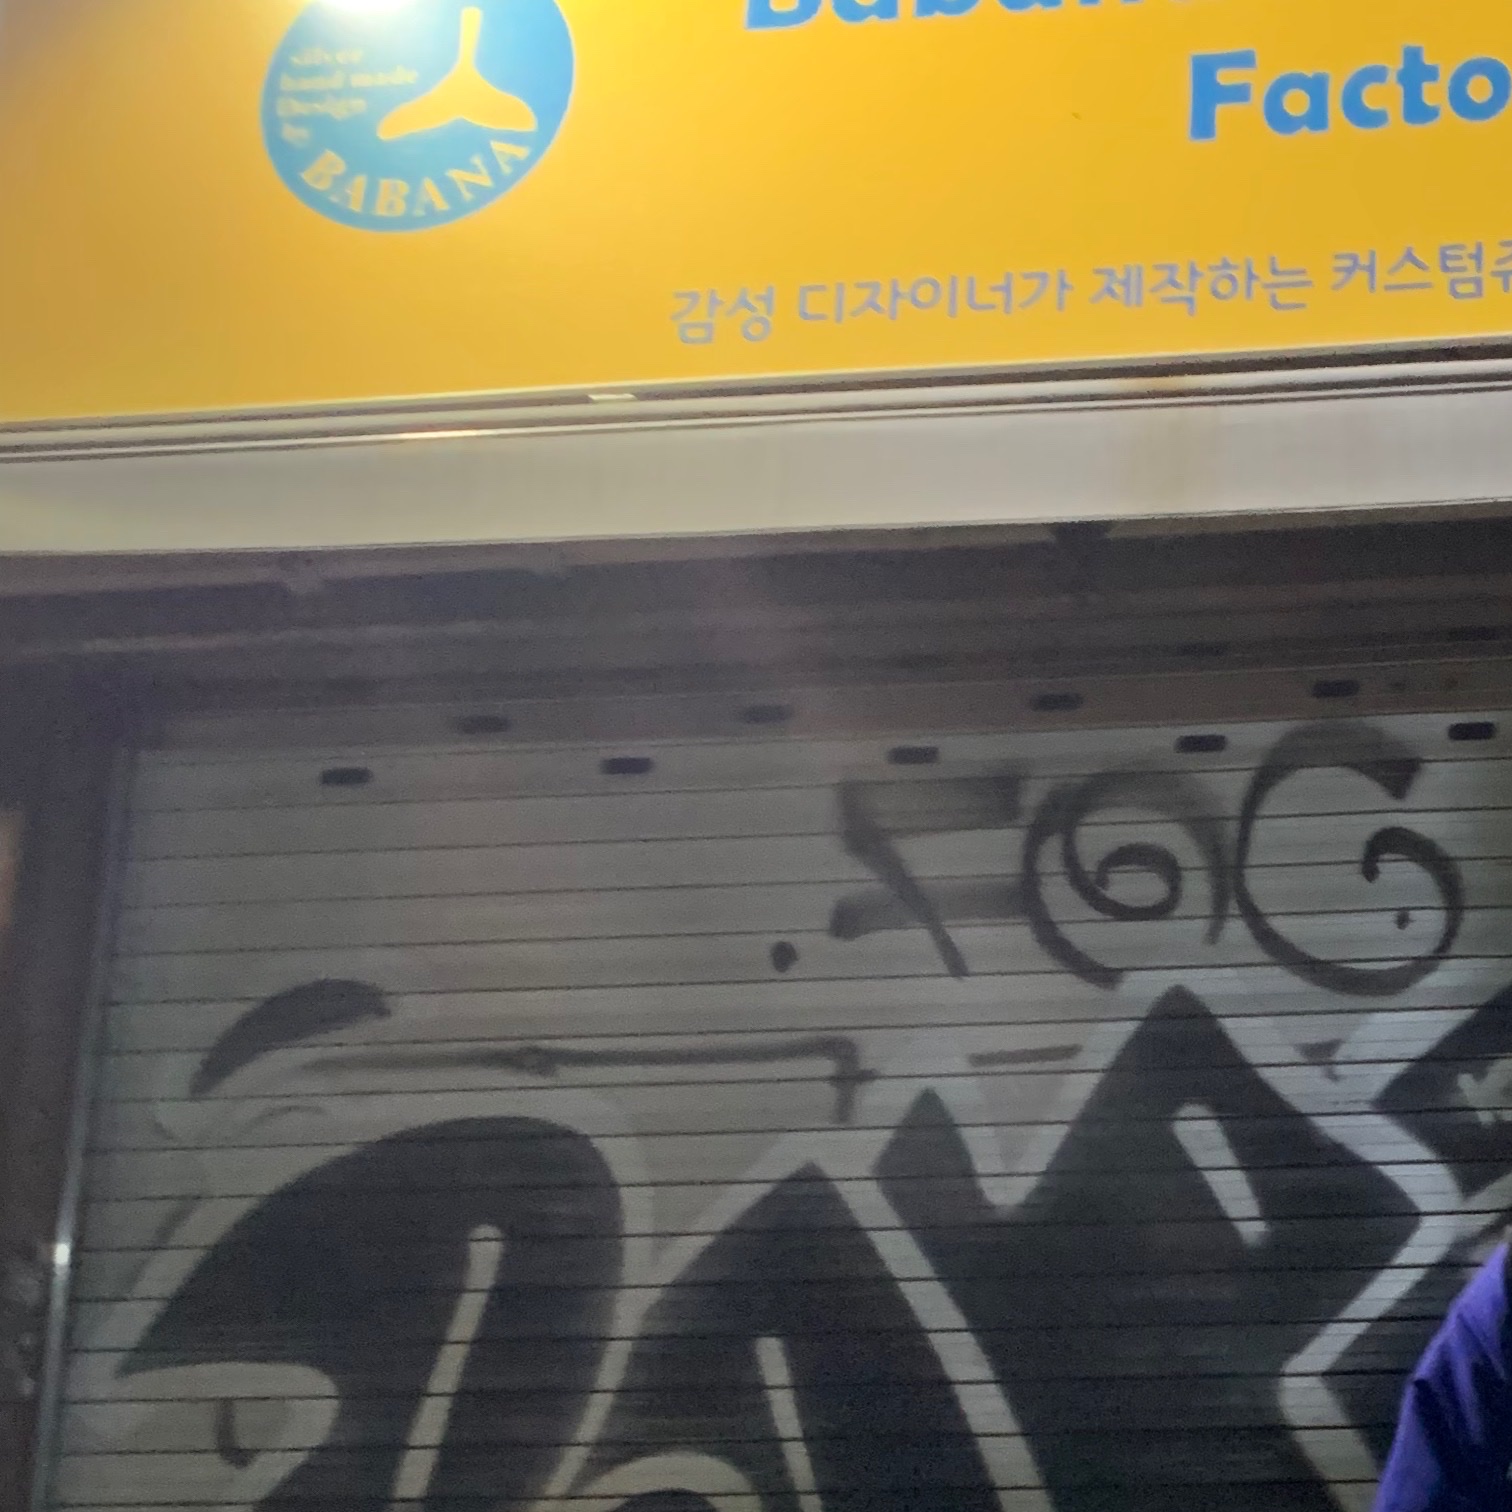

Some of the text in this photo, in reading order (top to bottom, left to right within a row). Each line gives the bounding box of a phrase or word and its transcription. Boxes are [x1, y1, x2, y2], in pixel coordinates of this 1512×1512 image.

[300, 139, 532, 217] BABANA
[671, 284, 777, 345] 감성
[797, 268, 1074, 324] 디자이너가
[1091, 255, 1313, 316] 제작하는
